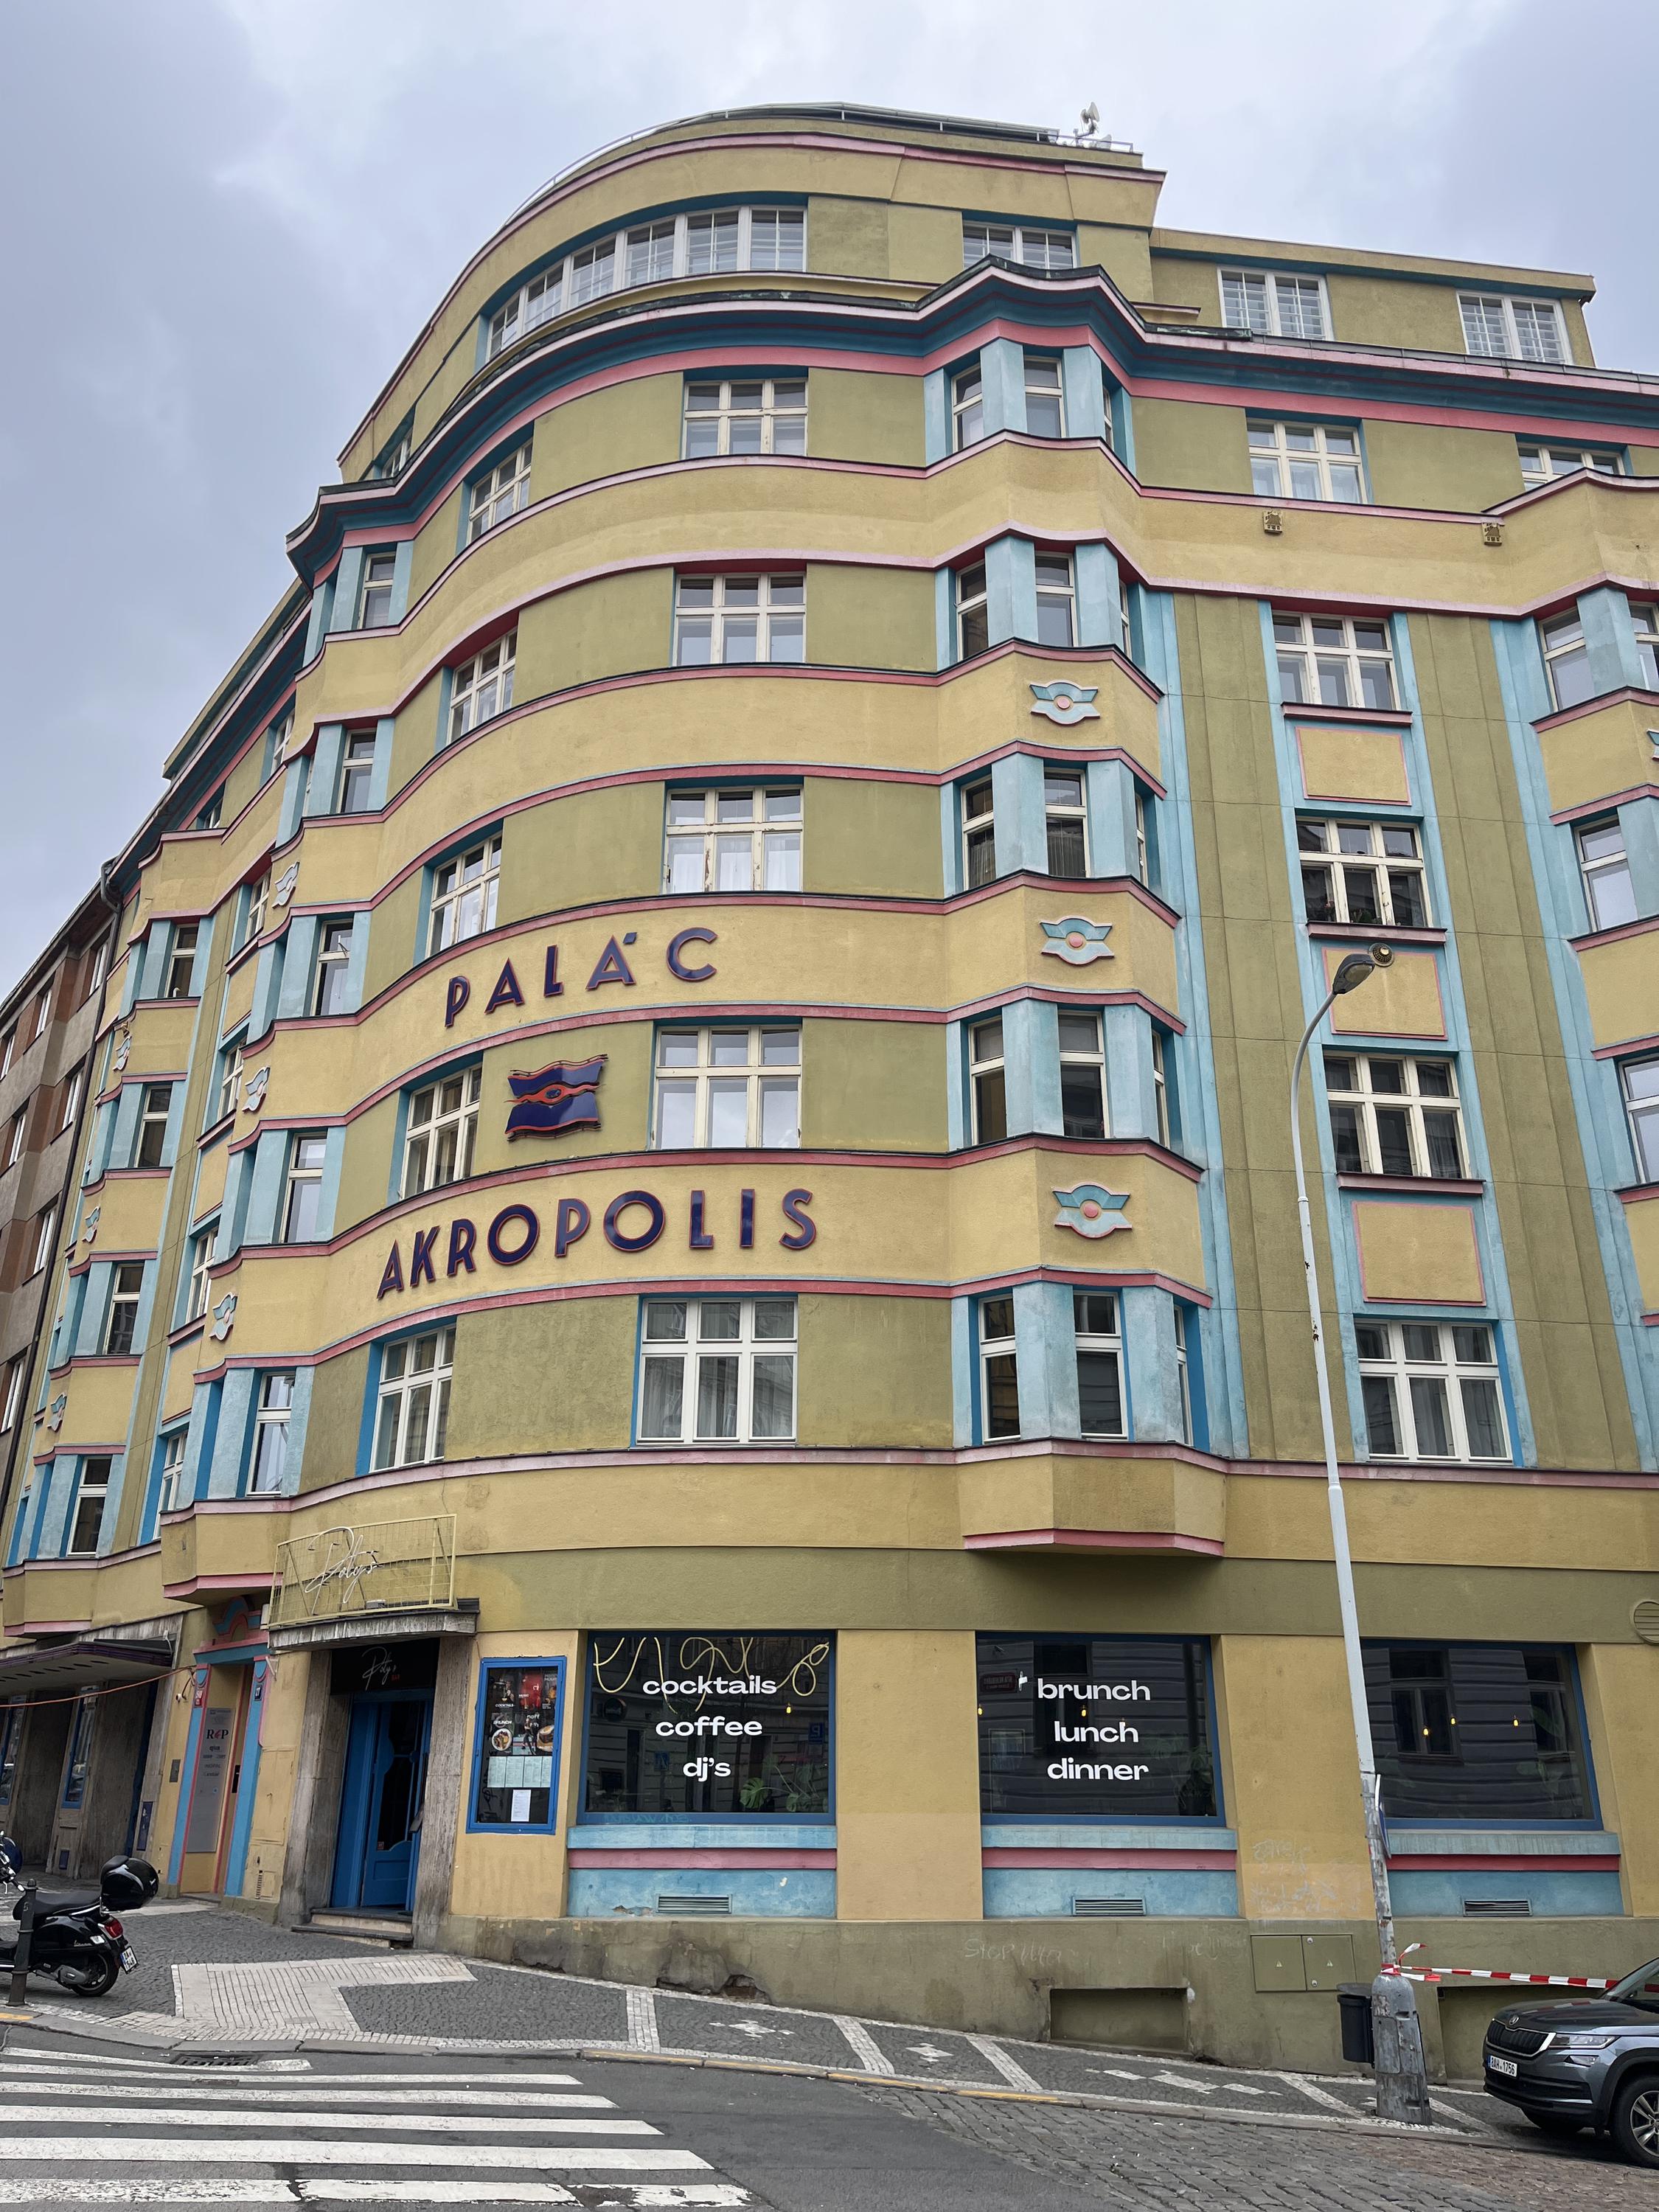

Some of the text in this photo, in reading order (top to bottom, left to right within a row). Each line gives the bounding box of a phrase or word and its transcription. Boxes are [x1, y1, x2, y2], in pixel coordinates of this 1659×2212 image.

[445, 927, 718, 1027] PALÁC
[377, 1188, 817, 1300] AKROPOLIS
[642, 1675, 777, 1695] cocktails
[1037, 1677, 1151, 1702] brunch
[655, 1715, 763, 1737] coffee
[1054, 1720, 1139, 1743] lunch
[683, 1756, 731, 1782] dj's
[1047, 1757, 1150, 1781] dinner
